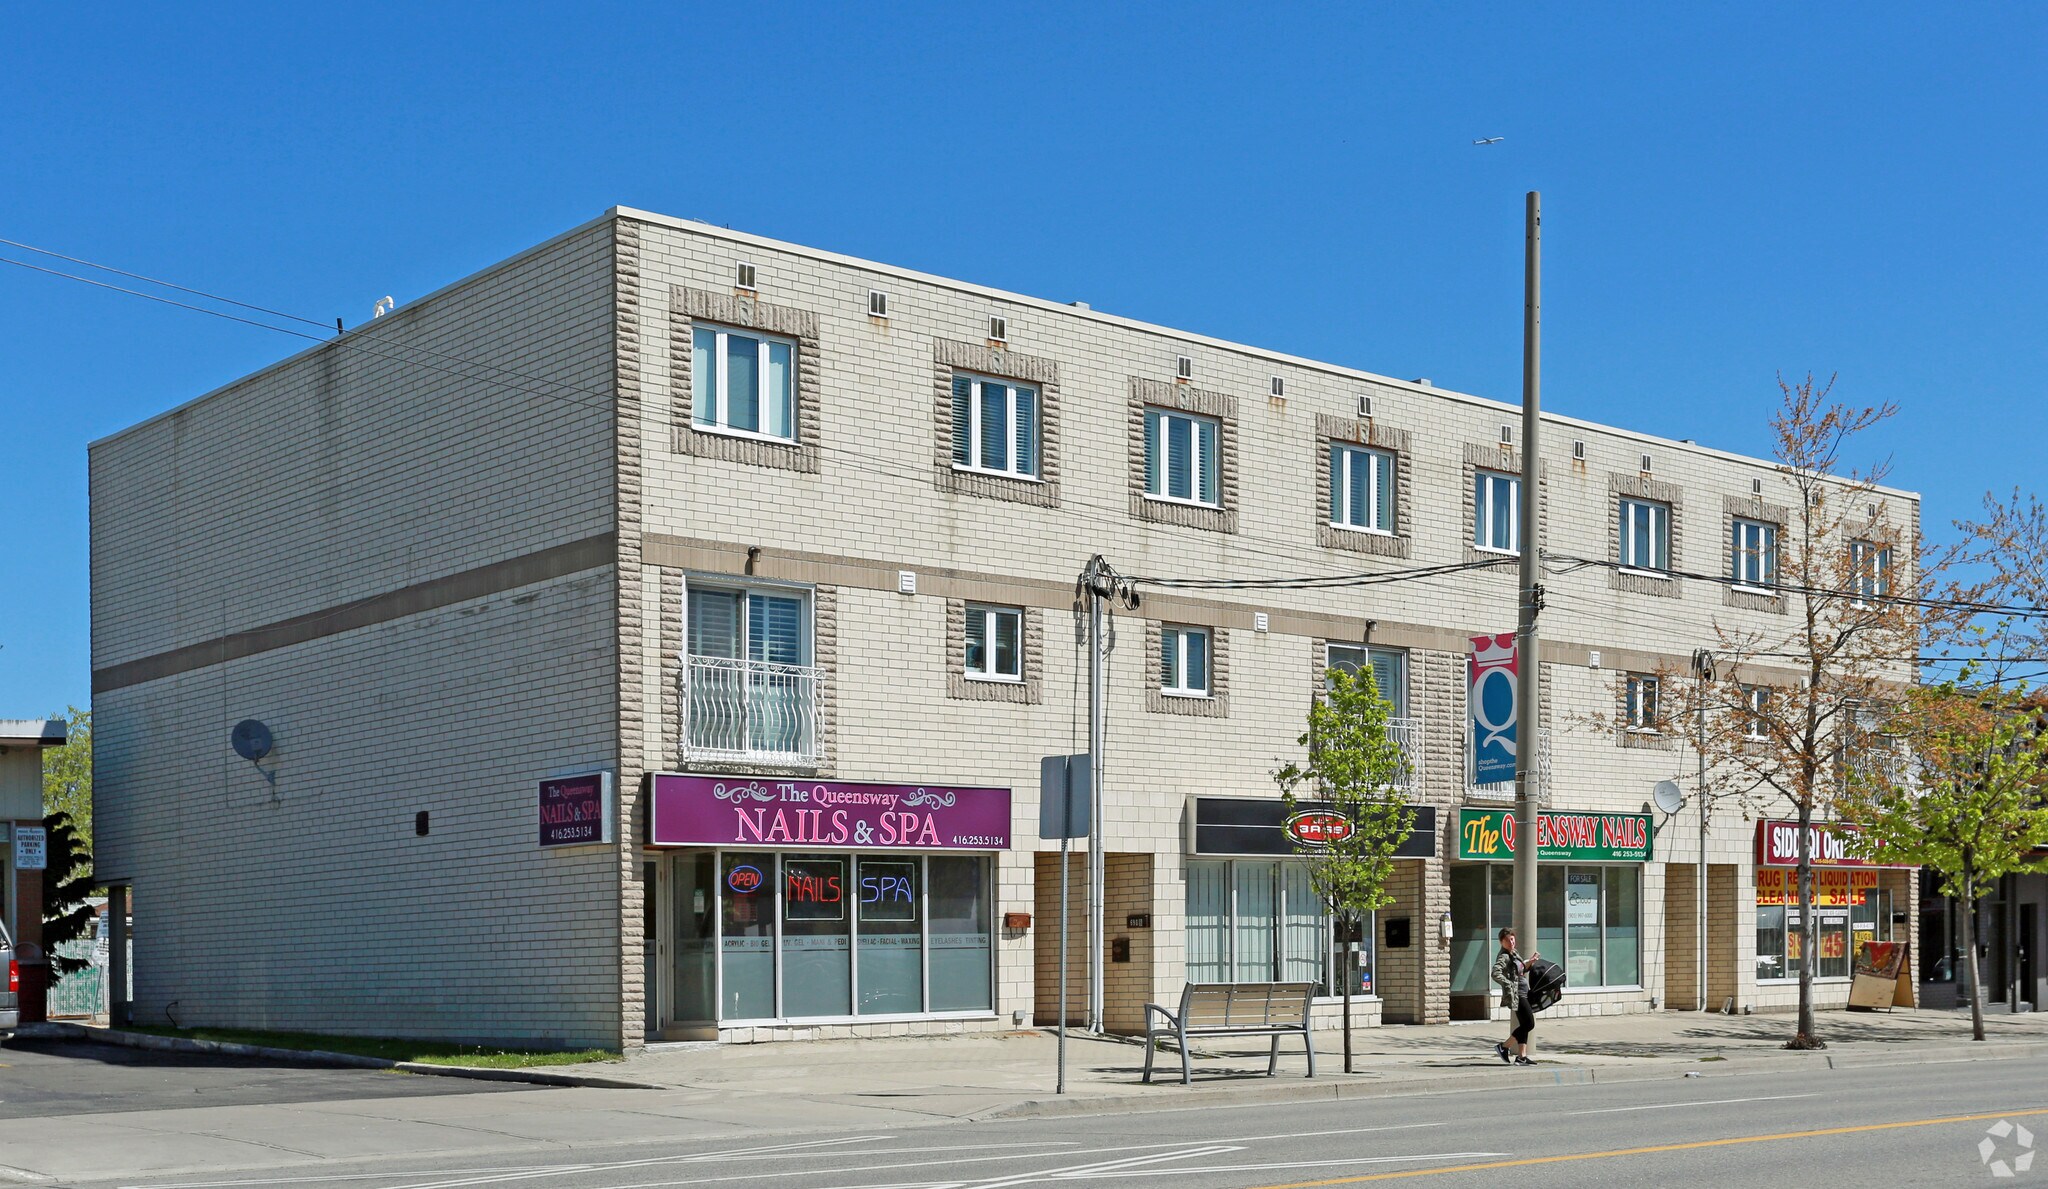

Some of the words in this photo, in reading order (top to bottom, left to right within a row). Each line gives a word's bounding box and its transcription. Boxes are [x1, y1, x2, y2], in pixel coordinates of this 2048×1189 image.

[1473, 667, 1517, 756] Q
[548, 786, 560, 798] The
[776, 783, 809, 802] The
[812, 785, 900, 811] Queensway
[540, 802, 573, 825] NAILS
[574, 807, 581, 821] &
[581, 800, 602, 820] SPA
[550, 826, 593, 840] 416.253.5134
[734, 807, 849, 844] NAILS
[853, 819, 874, 845] &
[879, 811, 942, 846] SPA
[1464, 815, 1499, 855] The
[1501, 813, 1599, 853] QENSWAY
[1602, 816, 1647, 849] NAILS
[952, 835, 1004, 846] 416.253.5134
[1773, 826, 1820, 861] SIDDQI
[731, 872, 760, 887] OPEN
[788, 875, 841, 902] NAILS
[1570, 874, 1580, 883] FOR
[1580, 874, 1592, 883] SALE
[1757, 870, 1781, 887] RUG
[1787, 871, 1817, 885] RER
[1820, 871, 1877, 886] LIQUIDATION
[861, 877, 912, 902] SPA
[1829, 888, 1867, 904] SALE
